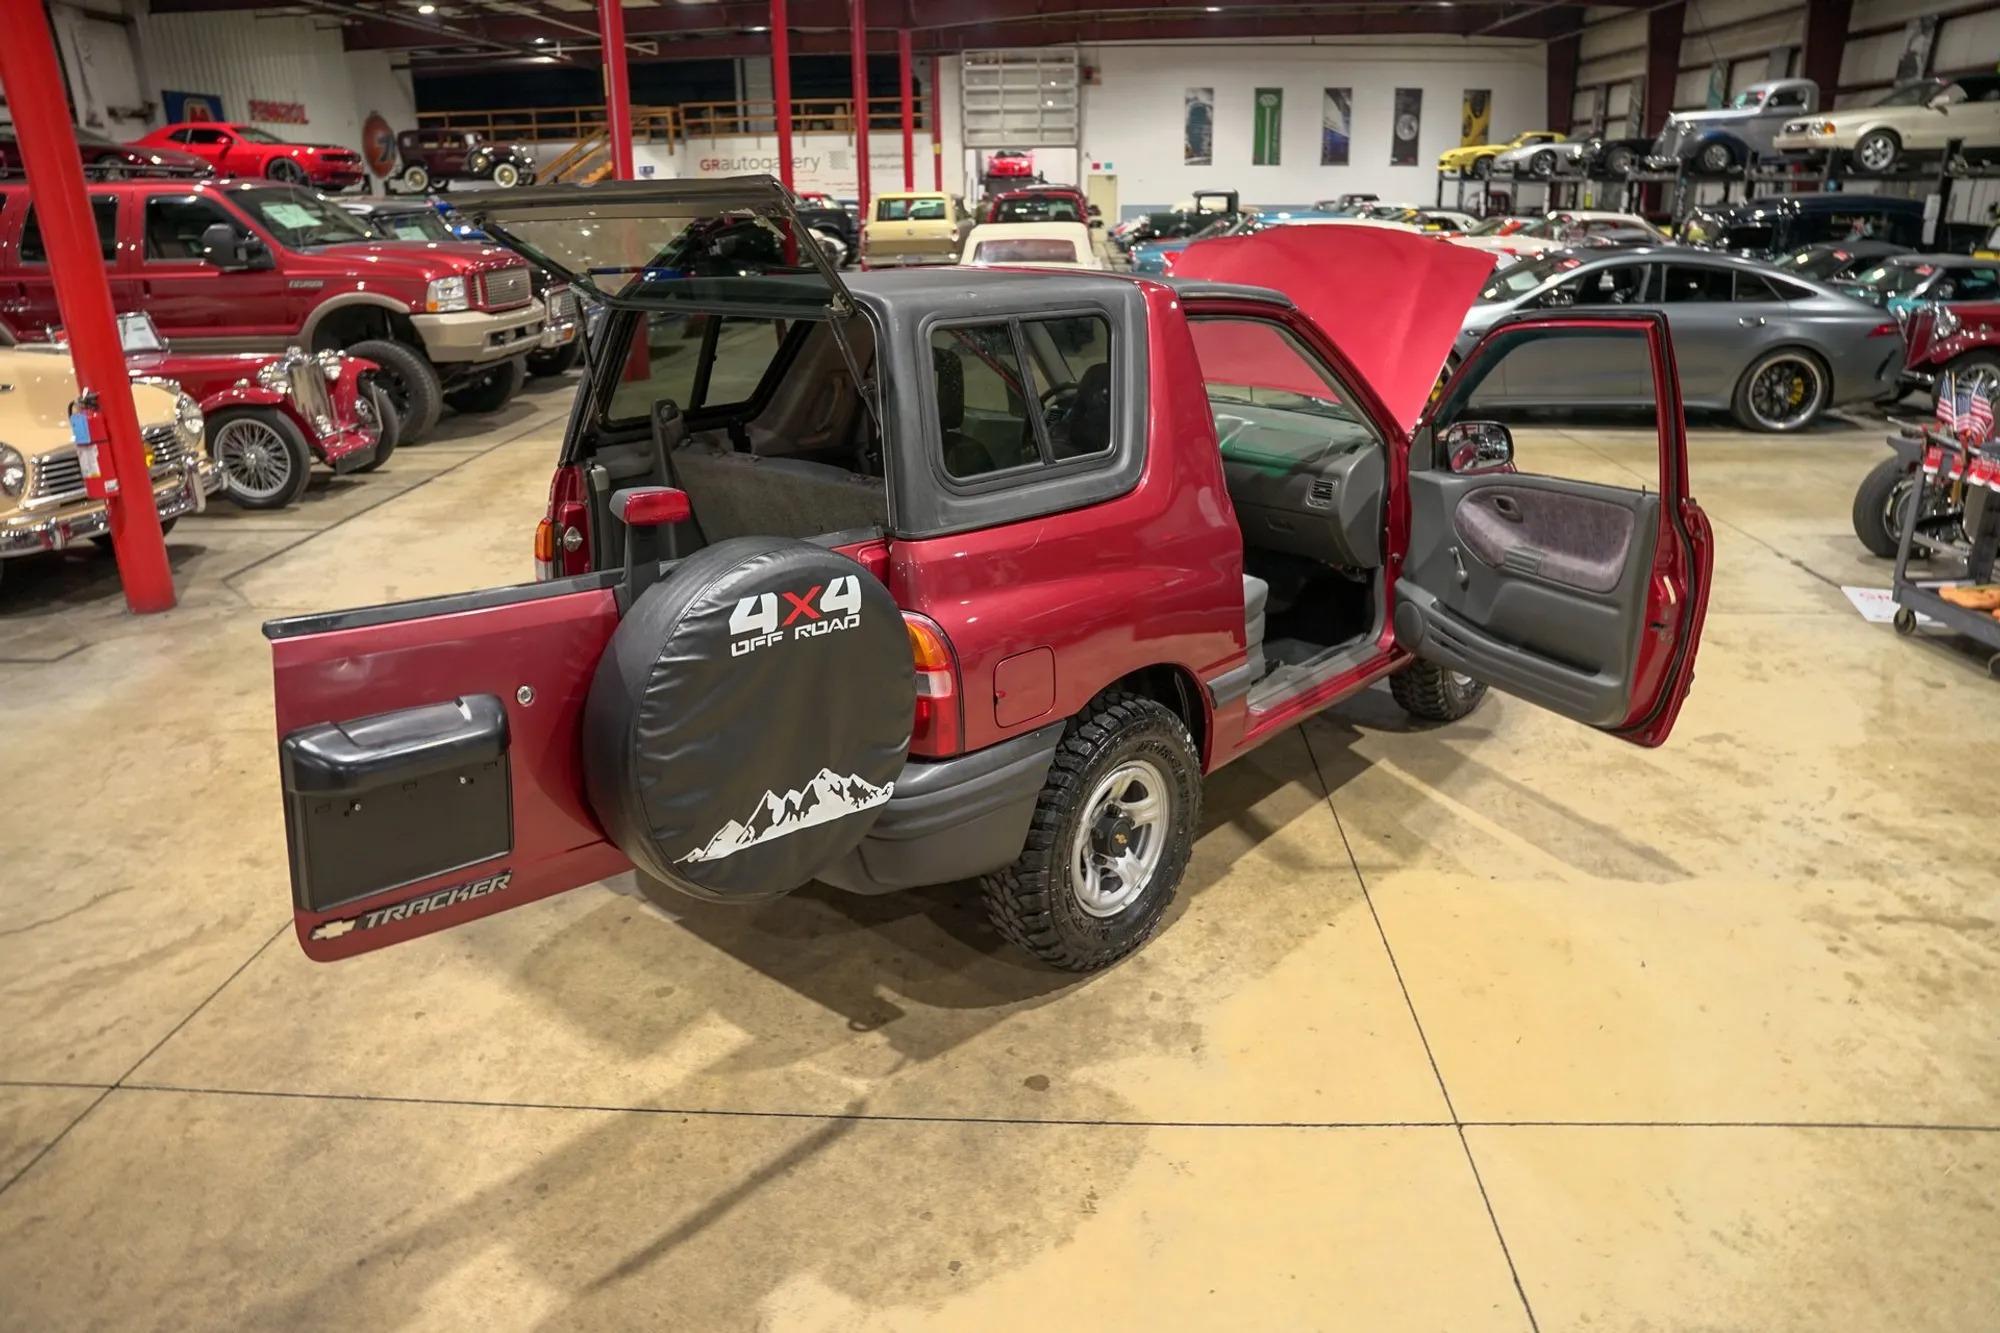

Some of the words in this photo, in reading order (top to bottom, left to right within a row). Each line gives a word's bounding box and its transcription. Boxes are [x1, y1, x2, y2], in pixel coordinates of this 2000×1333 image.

[700, 155, 821, 174] GRautogaery
[731, 631, 783, 657] OFF
[795, 614, 860, 640] ROAD
[366, 874, 512, 929] TRACKER
